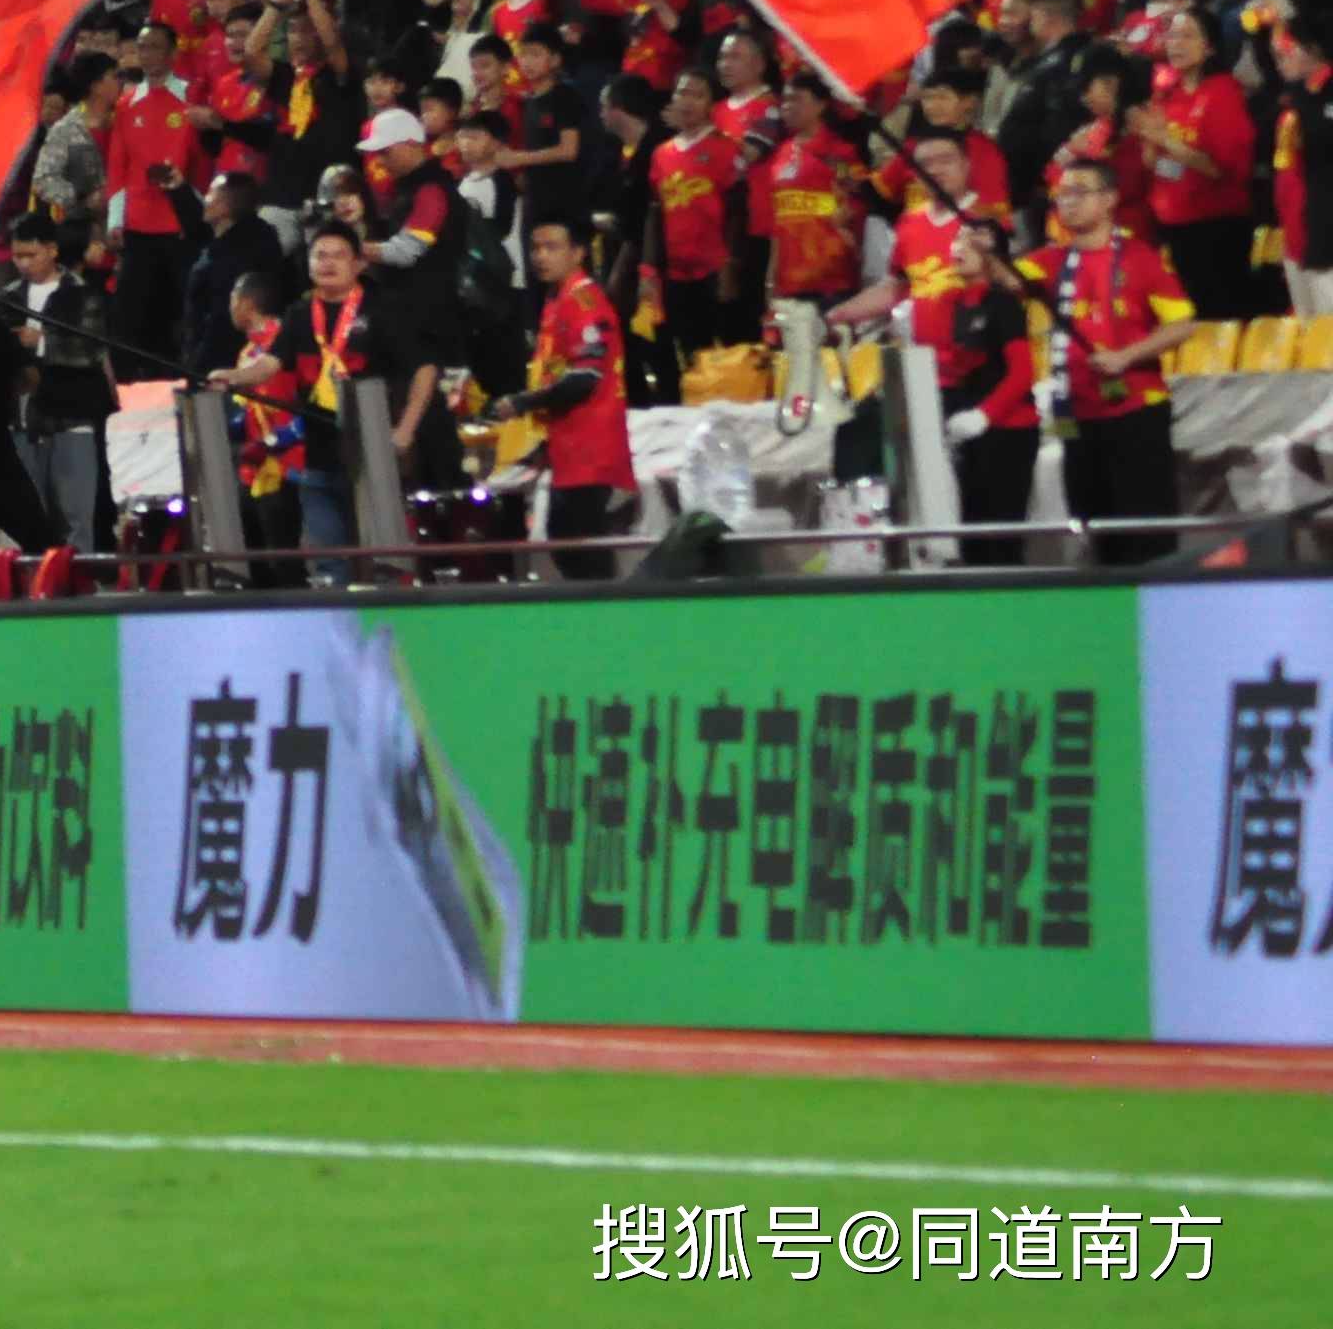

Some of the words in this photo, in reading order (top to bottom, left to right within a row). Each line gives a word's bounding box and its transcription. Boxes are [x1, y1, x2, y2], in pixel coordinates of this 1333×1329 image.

[173, 672, 330, 944] 魔力
[525, 686, 1099, 950] 快速补充电解质和能量
[1210, 651, 1333, 958] 魔
